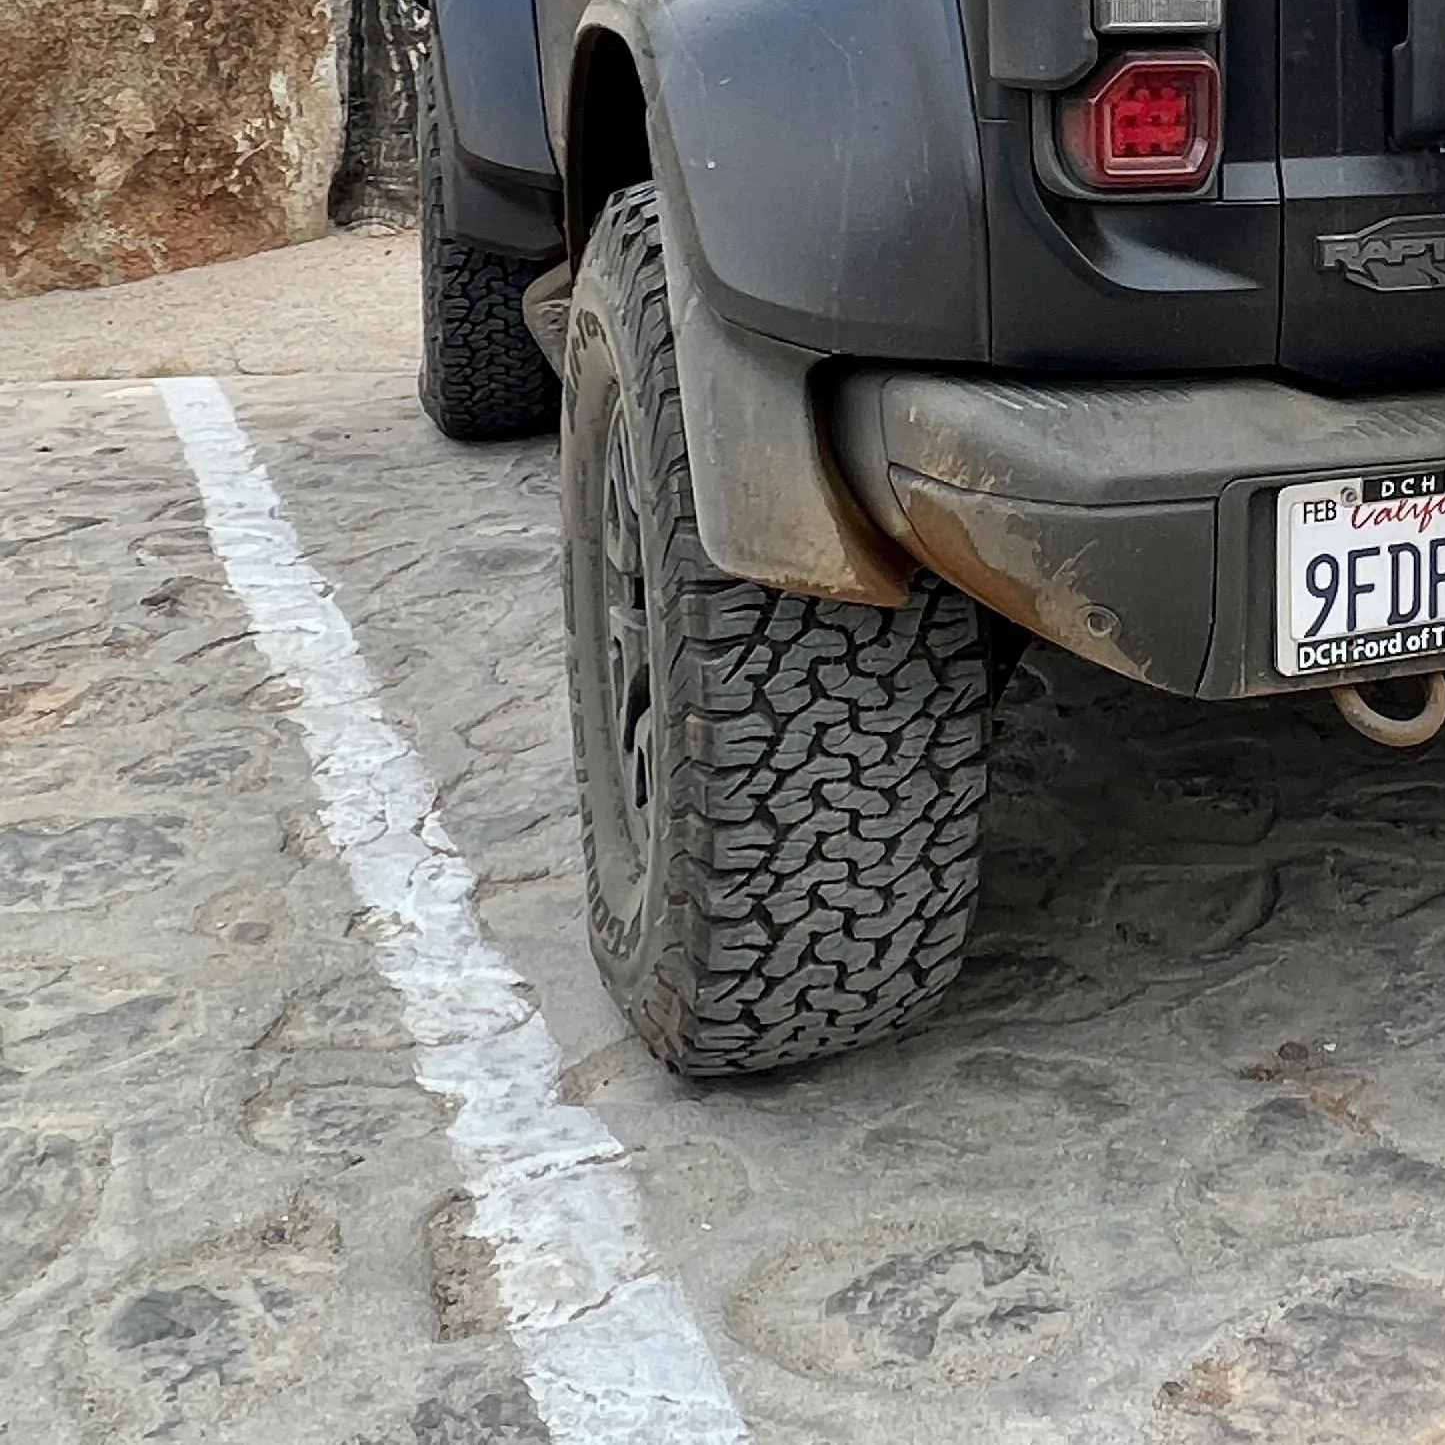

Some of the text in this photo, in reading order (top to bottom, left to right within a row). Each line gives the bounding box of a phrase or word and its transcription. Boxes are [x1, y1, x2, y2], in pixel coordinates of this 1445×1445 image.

[1380, 475, 1436, 499] DCH
[1302, 500, 1338, 524] FEB
[1298, 639, 1348, 669] DCH
[1352, 630, 1401, 661] Ford
[1405, 627, 1430, 654] of
